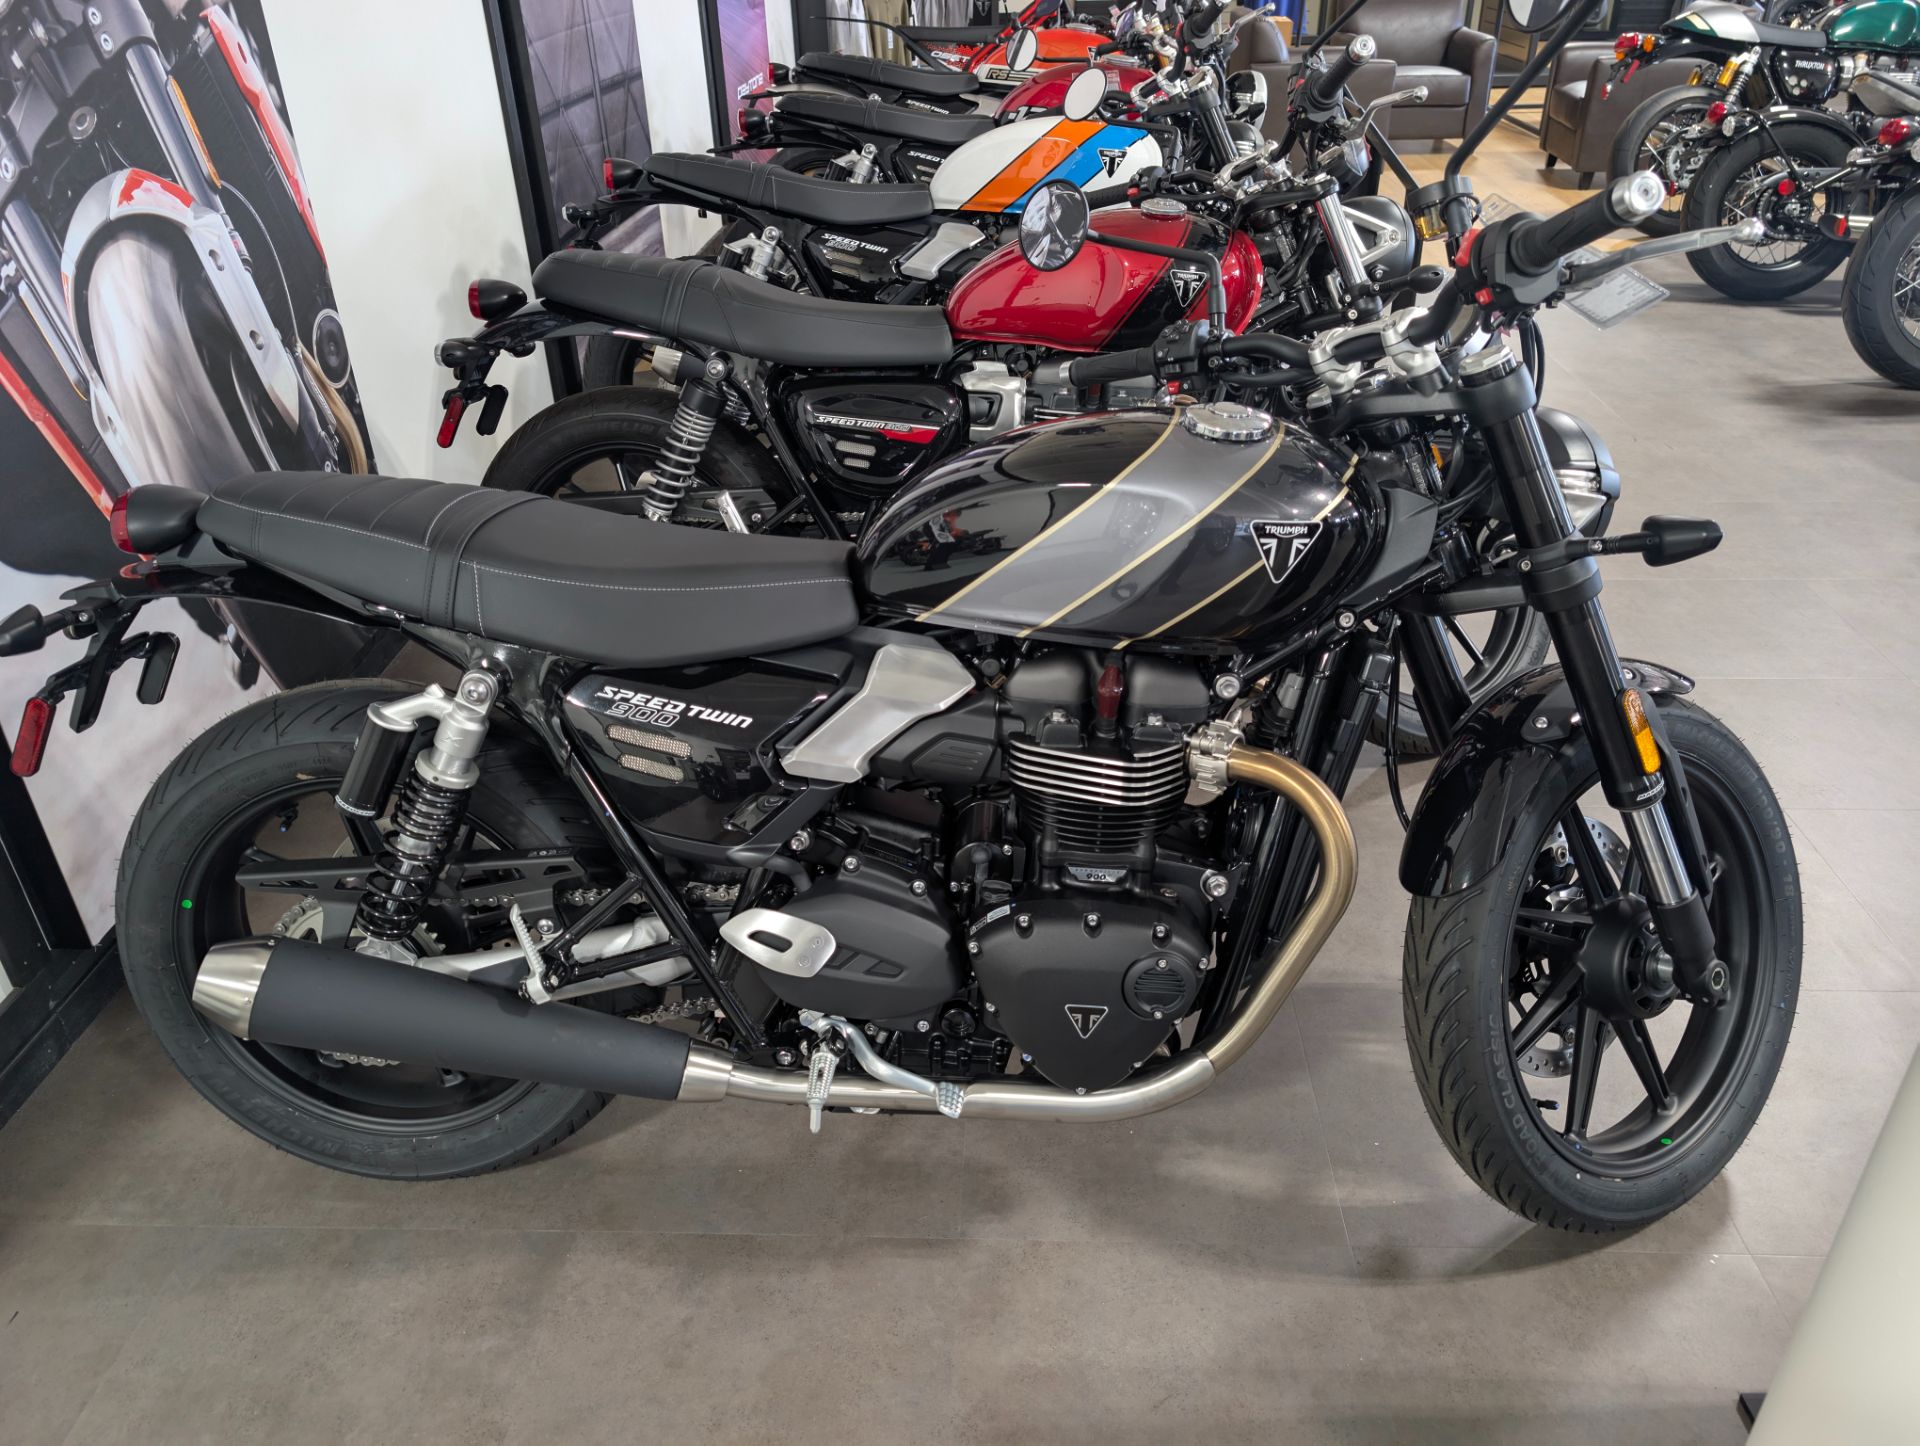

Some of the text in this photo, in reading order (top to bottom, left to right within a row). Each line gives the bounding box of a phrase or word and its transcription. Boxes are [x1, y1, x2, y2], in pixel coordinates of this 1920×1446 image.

[1795, 60, 1825, 71] THRUXTON
[988, 69, 1009, 80] RS
[907, 150, 941, 163] SPEED
[821, 233, 889, 254] SPEED TWIN
[825, 240, 858, 252] 900
[816, 416, 857, 426] SPEED
[855, 420, 886, 429] TWIN
[1264, 525, 1309, 535] TRIUMPH
[595, 685, 754, 729] SPEED TWIN
[603, 701, 680, 728] 900
[1086, 872, 1107, 881] 900
[1487, 1012, 1519, 1111] CLASSIC
